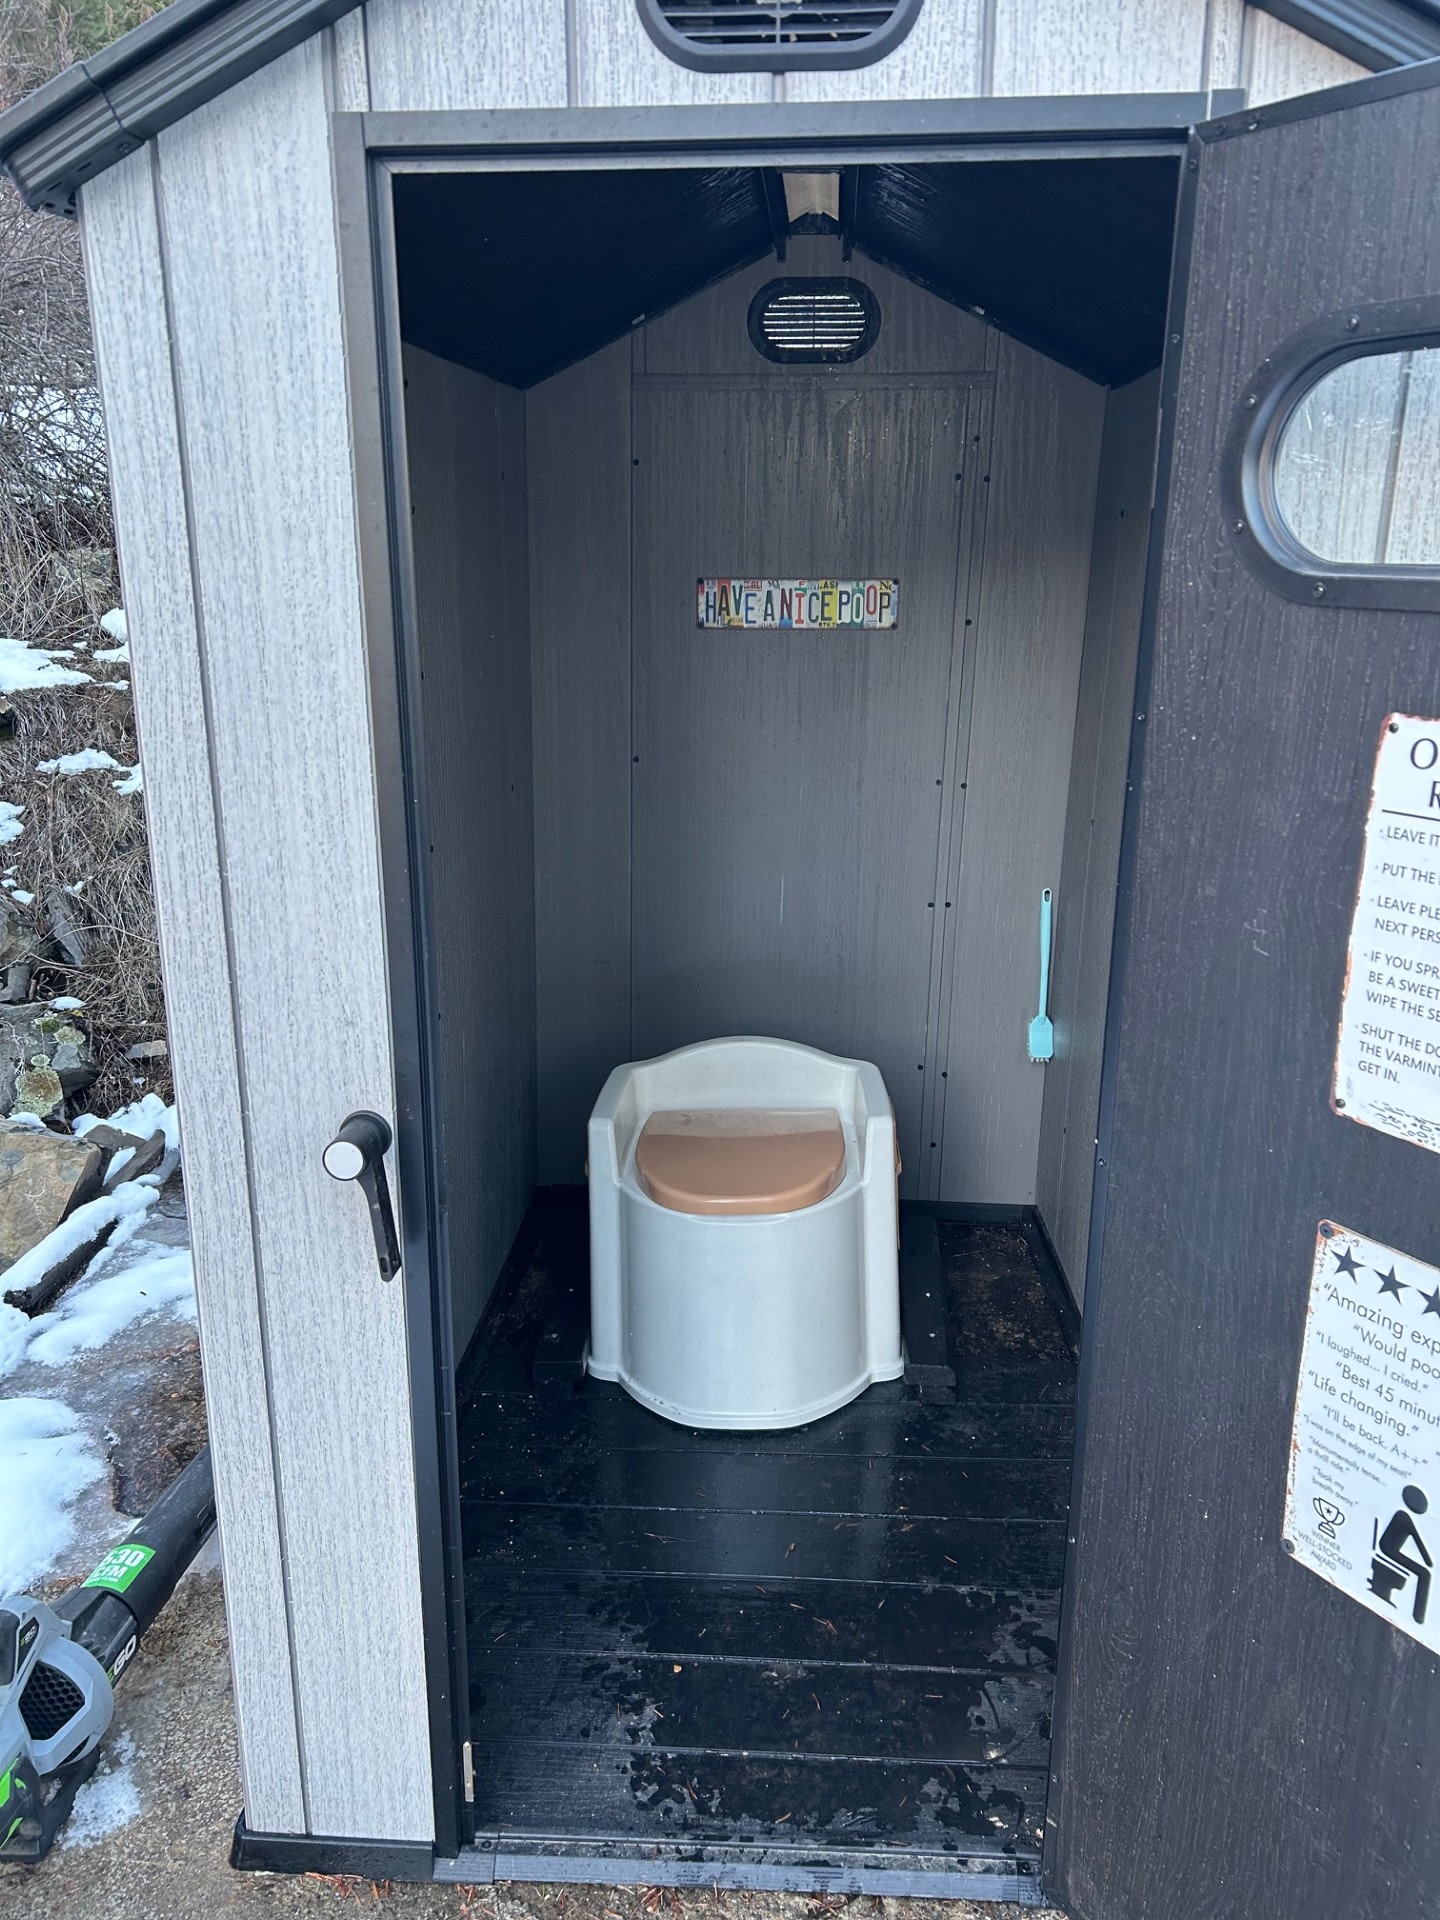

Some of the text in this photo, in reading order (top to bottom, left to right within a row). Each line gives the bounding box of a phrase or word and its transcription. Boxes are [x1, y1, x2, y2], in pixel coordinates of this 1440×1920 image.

[706, 584, 891, 625] HAVE A NICE POOP
[1410, 738, 1439, 770] O
[1387, 825, 1440, 847] LEAVE IT
[1382, 862, 1408, 878] PUT
[1411, 867, 1436, 885] THE
[1377, 894, 1417, 914] LEAVE
[1374, 918, 1408, 936] NEXT
[1370, 950, 1440, 980] IF YOU SPR
[1368, 970, 1440, 1000] BE A SWEET
[1366, 988, 1398, 1010] WIPE
[1400, 999, 1425, 1017] THE
[1359, 1040, 1383, 1058] THE
[1361, 1022, 1396, 1043] SHUT
[1397, 1033, 1422, 1051] THE
[1358, 1060, 1400, 1084] GET IN.
[1323, 1282, 1440, 1356] "Amazing exp
[1353, 1324, 1440, 1379] "Would poo
[1336, 1361, 1370, 1391] "Best
[1374, 1383, 1395, 1403] 45
[1308, 1369, 1420, 1437] "Life changing."
[1342, 1415, 1356, 1432] be
[1358, 1423, 1387, 1450] back.
[1297, 1529, 1354, 1572] WELL-STOCKED
[1311, 1527, 1342, 1553] WINNER
[1311, 1549, 1338, 1572] AWARD
